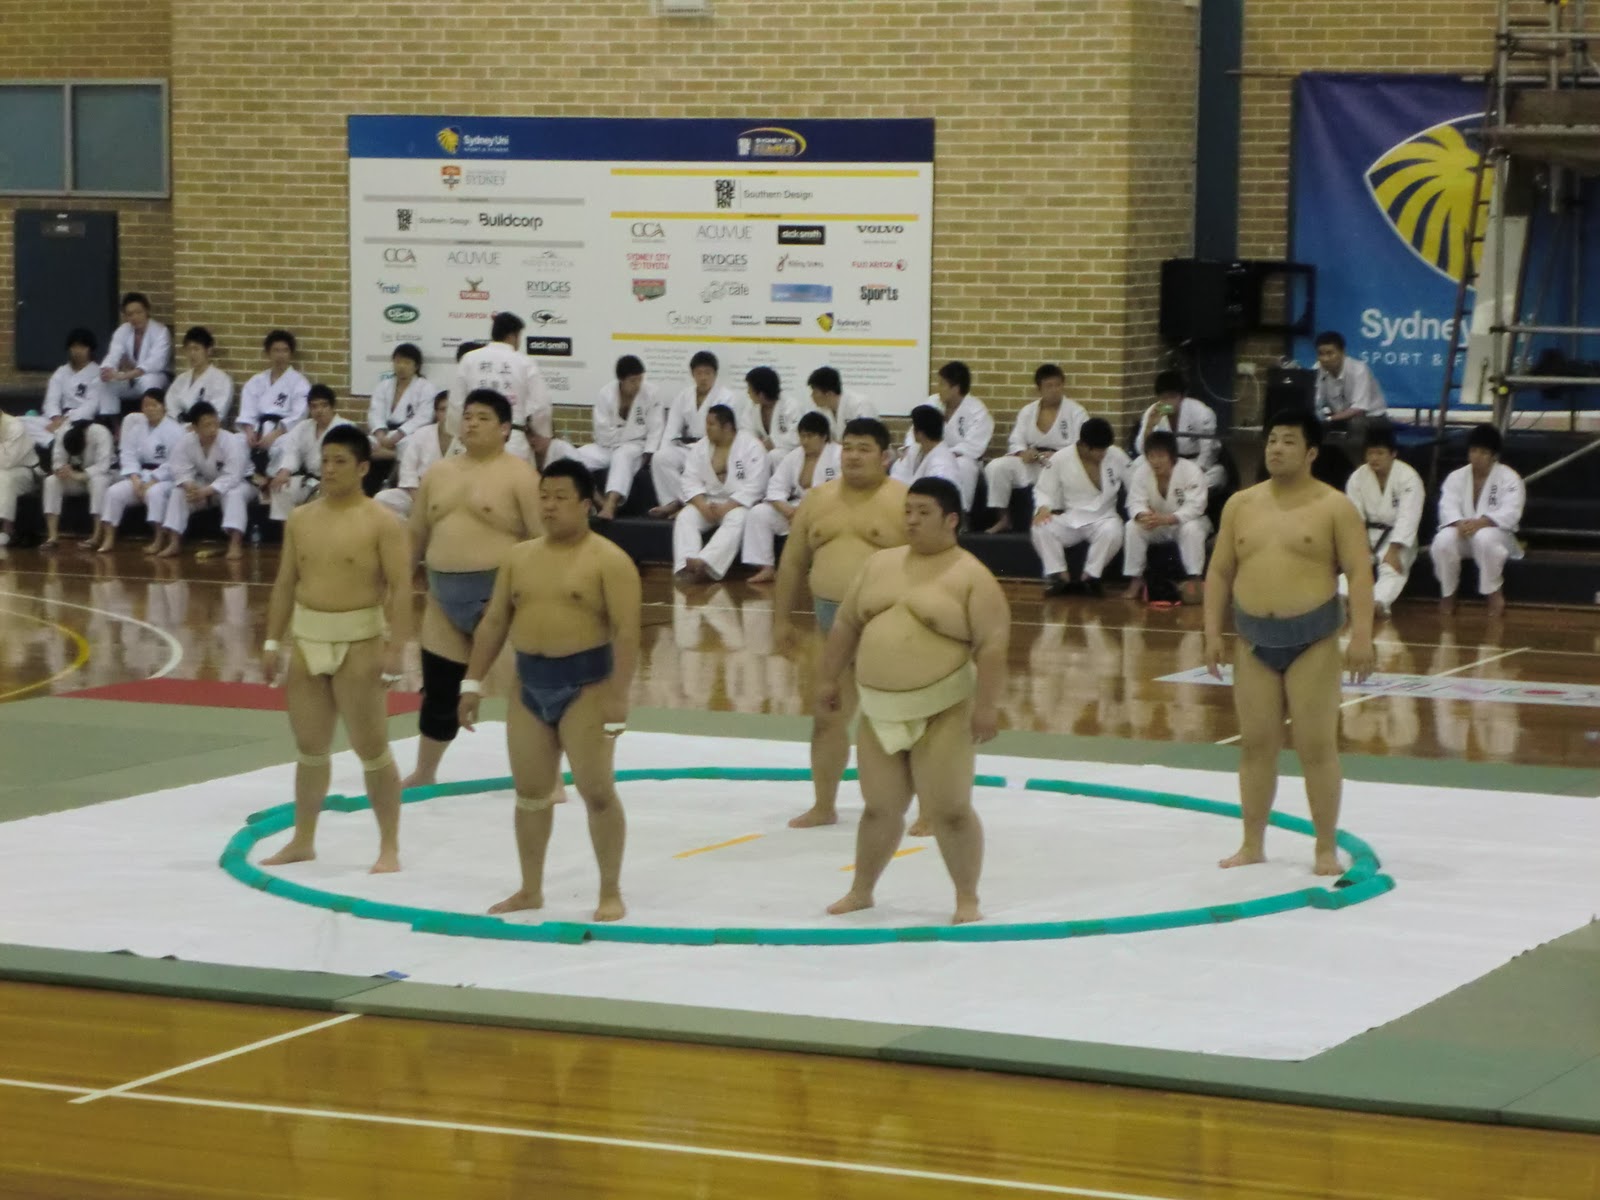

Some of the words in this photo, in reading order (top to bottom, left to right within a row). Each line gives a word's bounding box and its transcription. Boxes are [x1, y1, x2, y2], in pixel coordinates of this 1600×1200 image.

[463, 135, 493, 146] Sydney
[744, 190, 782, 198] Southern
[784, 190, 813, 200] Design
[479, 213, 543, 231] Buildcorp
[857, 225, 904, 233] VOLVO
[631, 222, 665, 237] CCA
[697, 225, 752, 239] ACUVUE
[384, 248, 417, 262] CCA
[448, 251, 501, 265] ACUVUE
[702, 254, 748, 265] RYDGES
[527, 281, 571, 292] RYDGES
[860, 286, 899, 305] Sports
[1360, 351, 1423, 366] SPORT
[1431, 353, 1443, 366] &
